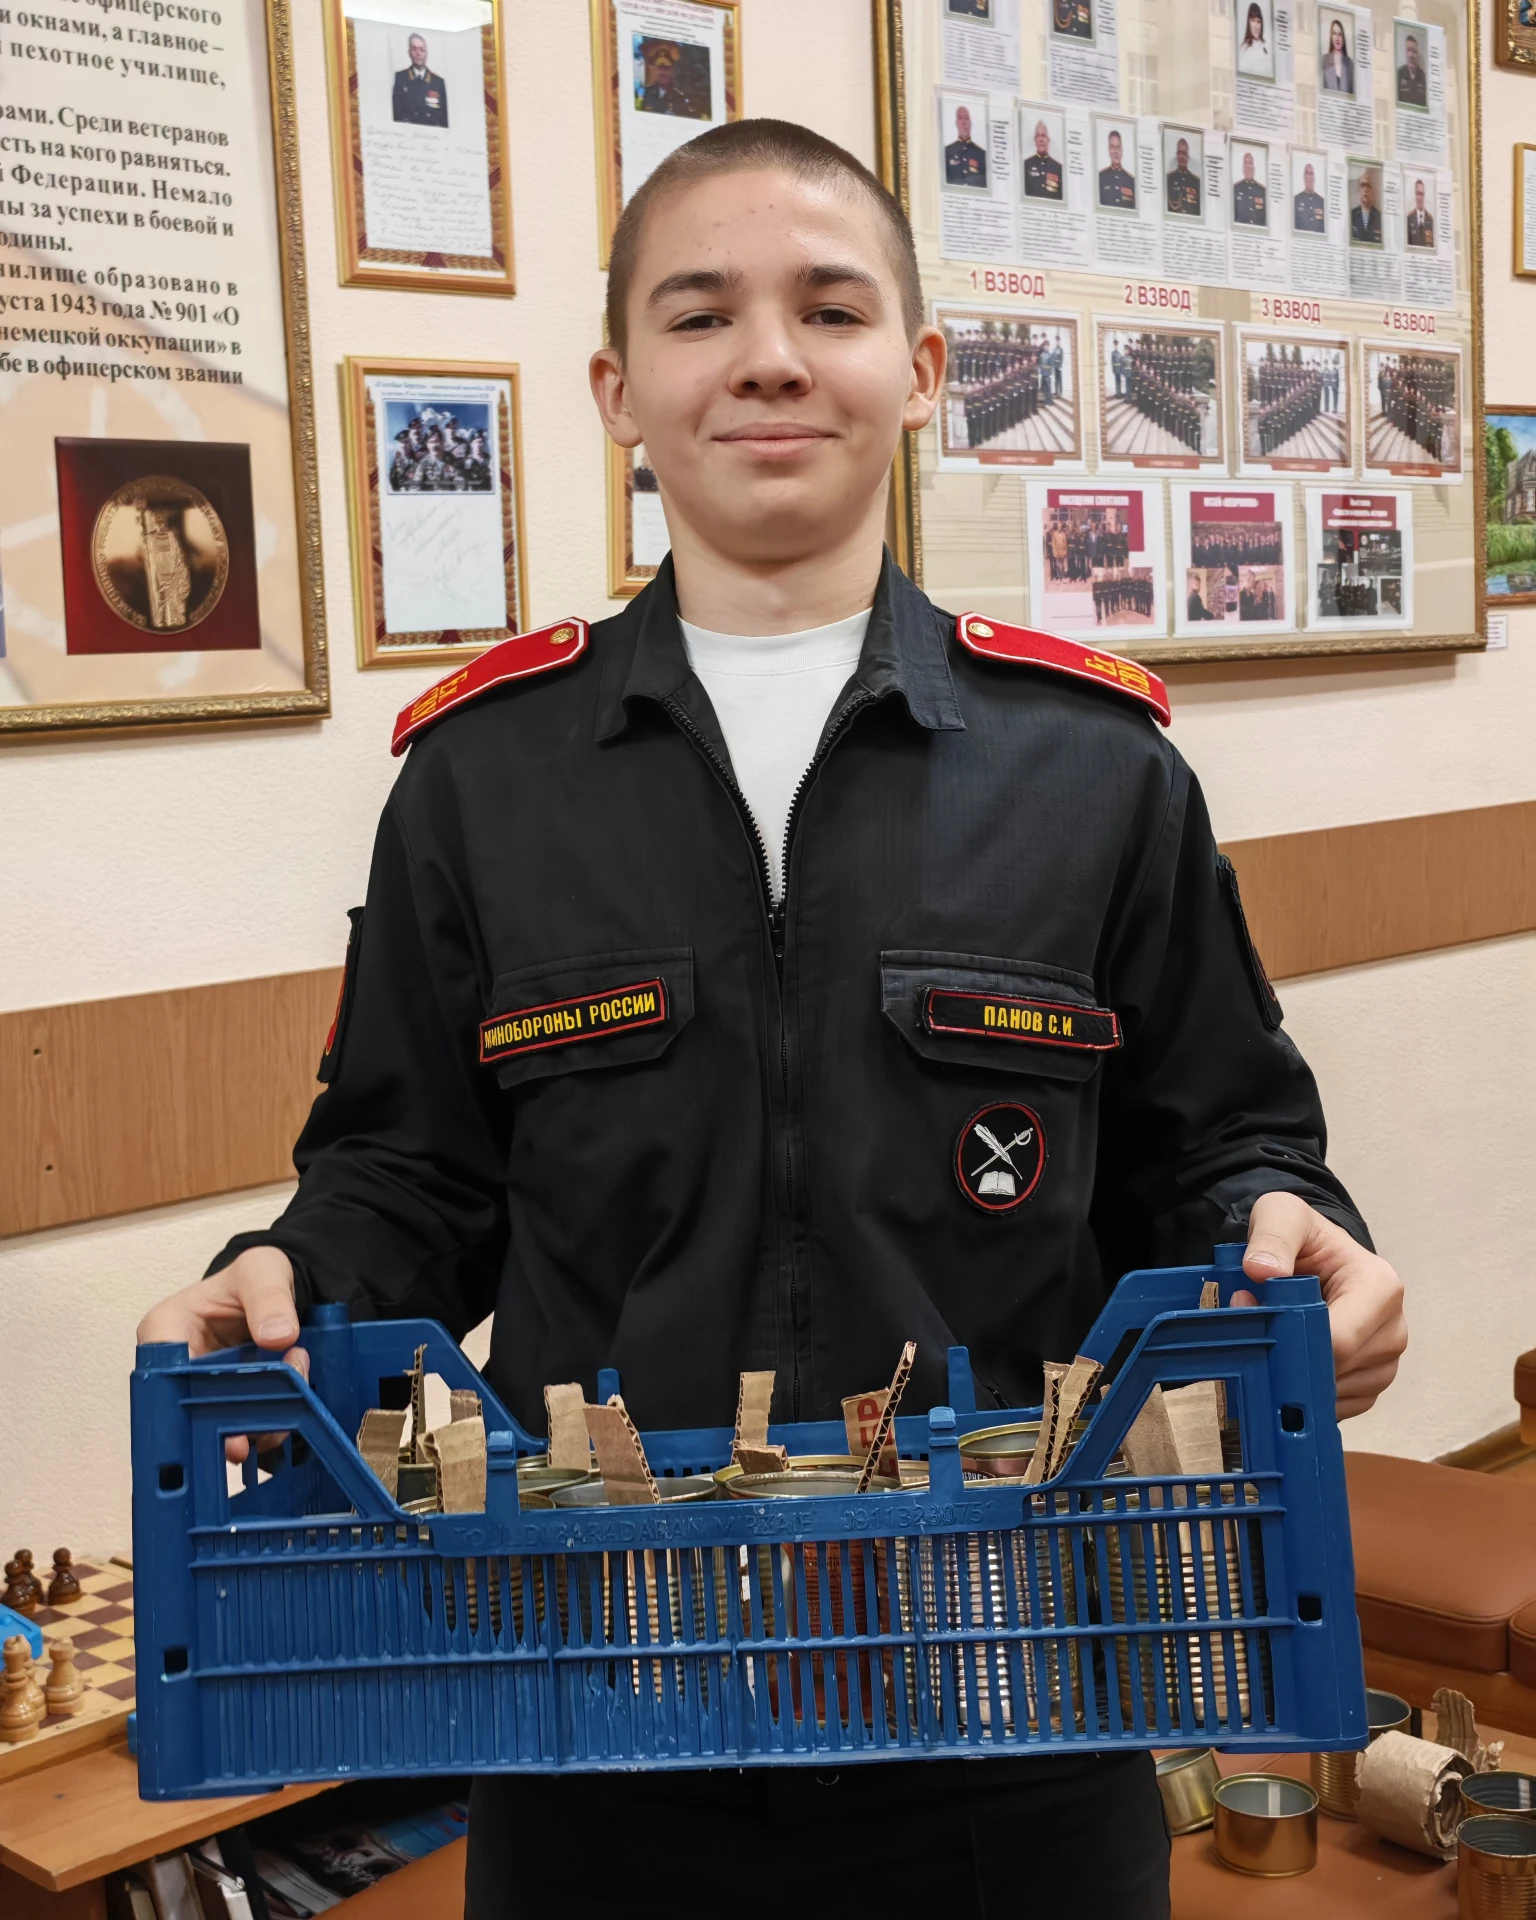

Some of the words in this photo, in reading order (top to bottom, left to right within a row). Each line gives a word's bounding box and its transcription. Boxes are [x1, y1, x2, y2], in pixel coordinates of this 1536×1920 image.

[17, 12, 108, 43] окнами,
[112, 26, 123, 41] а
[128, 28, 209, 54] главное
[10, 42, 115, 71] пехотное
[120, 58, 226, 91] училище,
[58, 106, 123, 134] Среди
[128, 120, 229, 147] ветеранов
[0, 136, 36, 155] сть
[40, 140, 65, 158] на
[70, 144, 117, 164] кого
[120, 150, 231, 177] равняться.
[11, 164, 146, 198] Федерации.
[152, 179, 233, 207] Немало
[30, 202, 52, 218] за
[56, 205, 129, 226] успехи
[134, 213, 145, 228] в
[149, 209, 218, 236] боевой
[222, 222, 234, 237] и
[0, 231, 73, 252] одины.
[94, 266, 221, 295] образовано
[227, 281, 238, 296] в
[970, 269, 977, 291] 1
[984, 271, 1046, 300] ВЗВОД
[50, 293, 97, 315] 1943
[101, 301, 146, 320] года
[149, 300, 172, 320] №
[175, 302, 206, 323] 901
[212, 306, 239, 326] «О
[1124, 284, 1133, 304] 2
[1137, 285, 1192, 313] ВЗВОД
[1261, 297, 1270, 316] 3
[1273, 298, 1321, 325] ВЗВОД
[1383, 311, 1390, 328] 4
[1393, 311, 1436, 336] ВЗВОД
[0, 325, 101, 346] немецкой
[105, 332, 227, 355] оккупации»
[231, 341, 242, 355] в
[0, 352, 23, 373] бе
[27, 358, 39, 373] в
[43, 354, 171, 383] офицерском
[174, 367, 243, 384] звании
[485, 1009, 582, 1049] МИНОБОРОНЫ
[589, 992, 656, 1025] РОССИИ
[984, 1006, 1043, 1032] ПАНОВ
